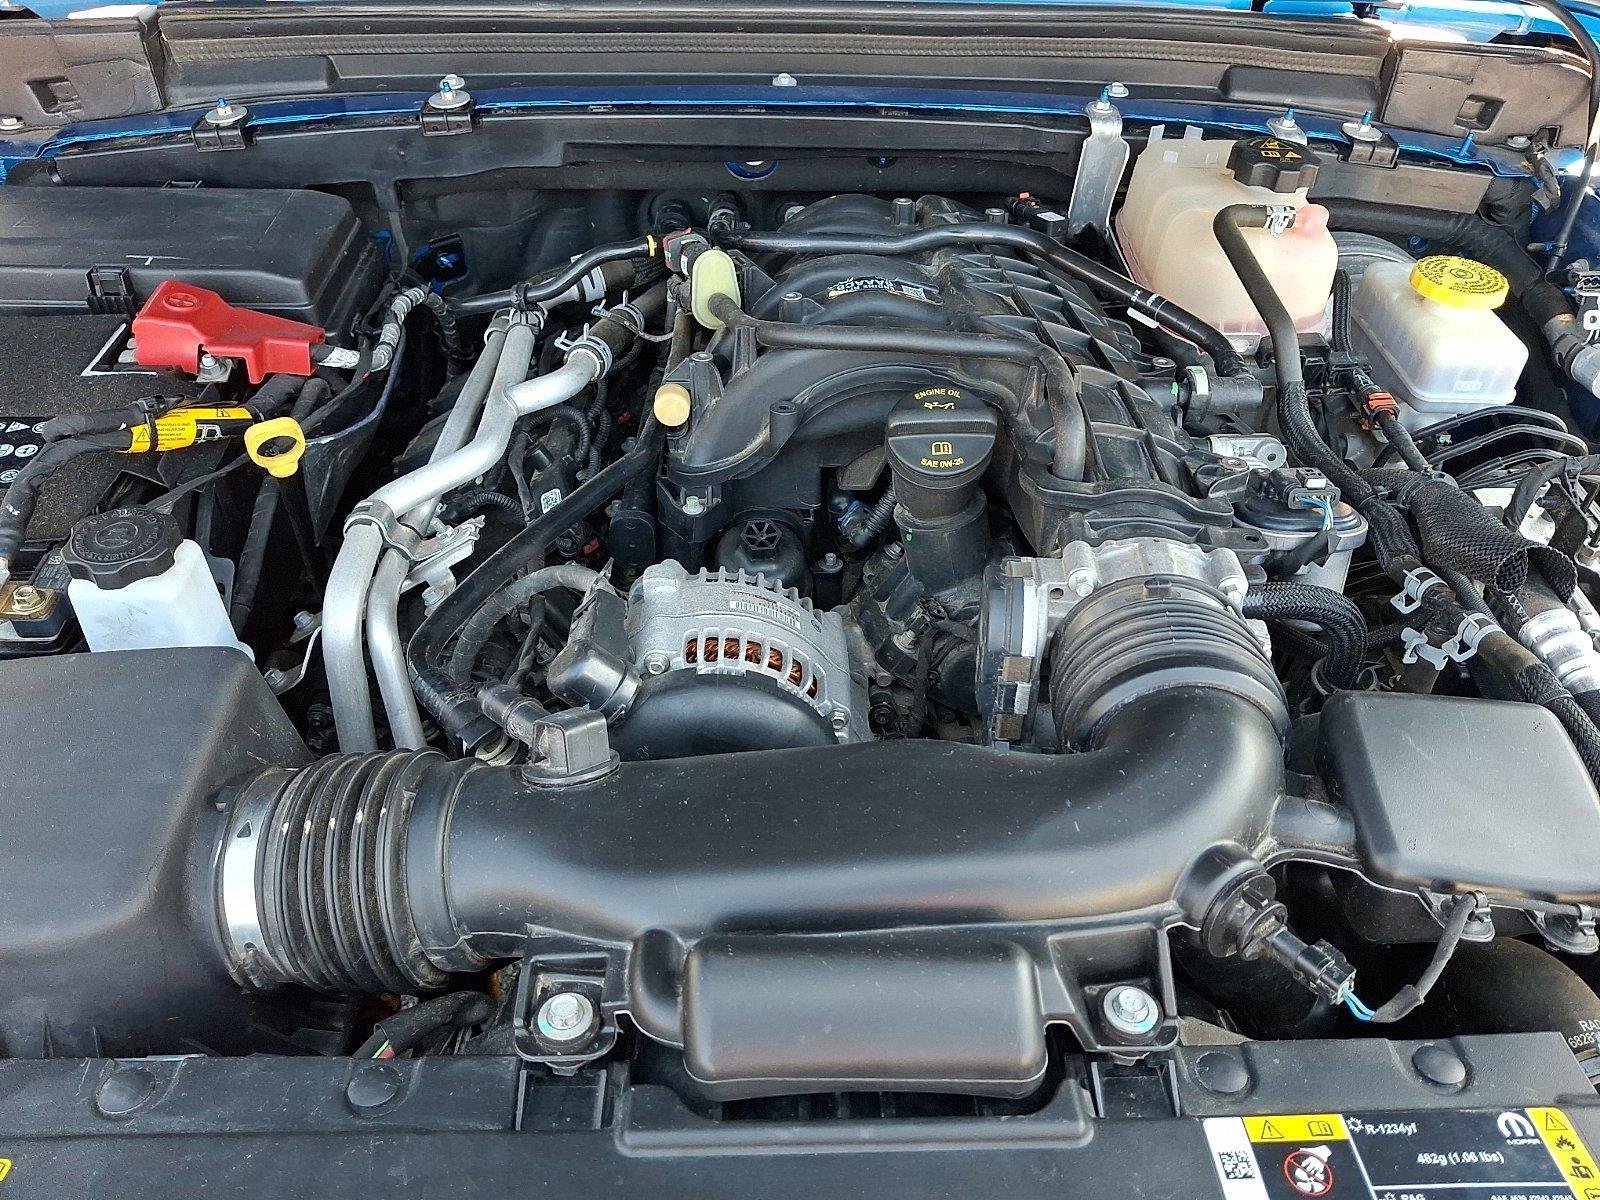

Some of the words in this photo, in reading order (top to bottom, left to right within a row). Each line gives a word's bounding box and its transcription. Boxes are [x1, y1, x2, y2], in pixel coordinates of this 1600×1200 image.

[914, 388, 946, 400] ENGINE
[947, 389, 961, 399] OIL
[920, 458, 938, 468] SAE
[939, 457, 964, 468] 0W-20
[1568, 1032, 1595, 1048] 6828
[1364, 1122, 1418, 1136] R-1234yf
[1416, 1152, 1448, 1166] 482g
[1478, 1151, 1505, 1165] lbs)
